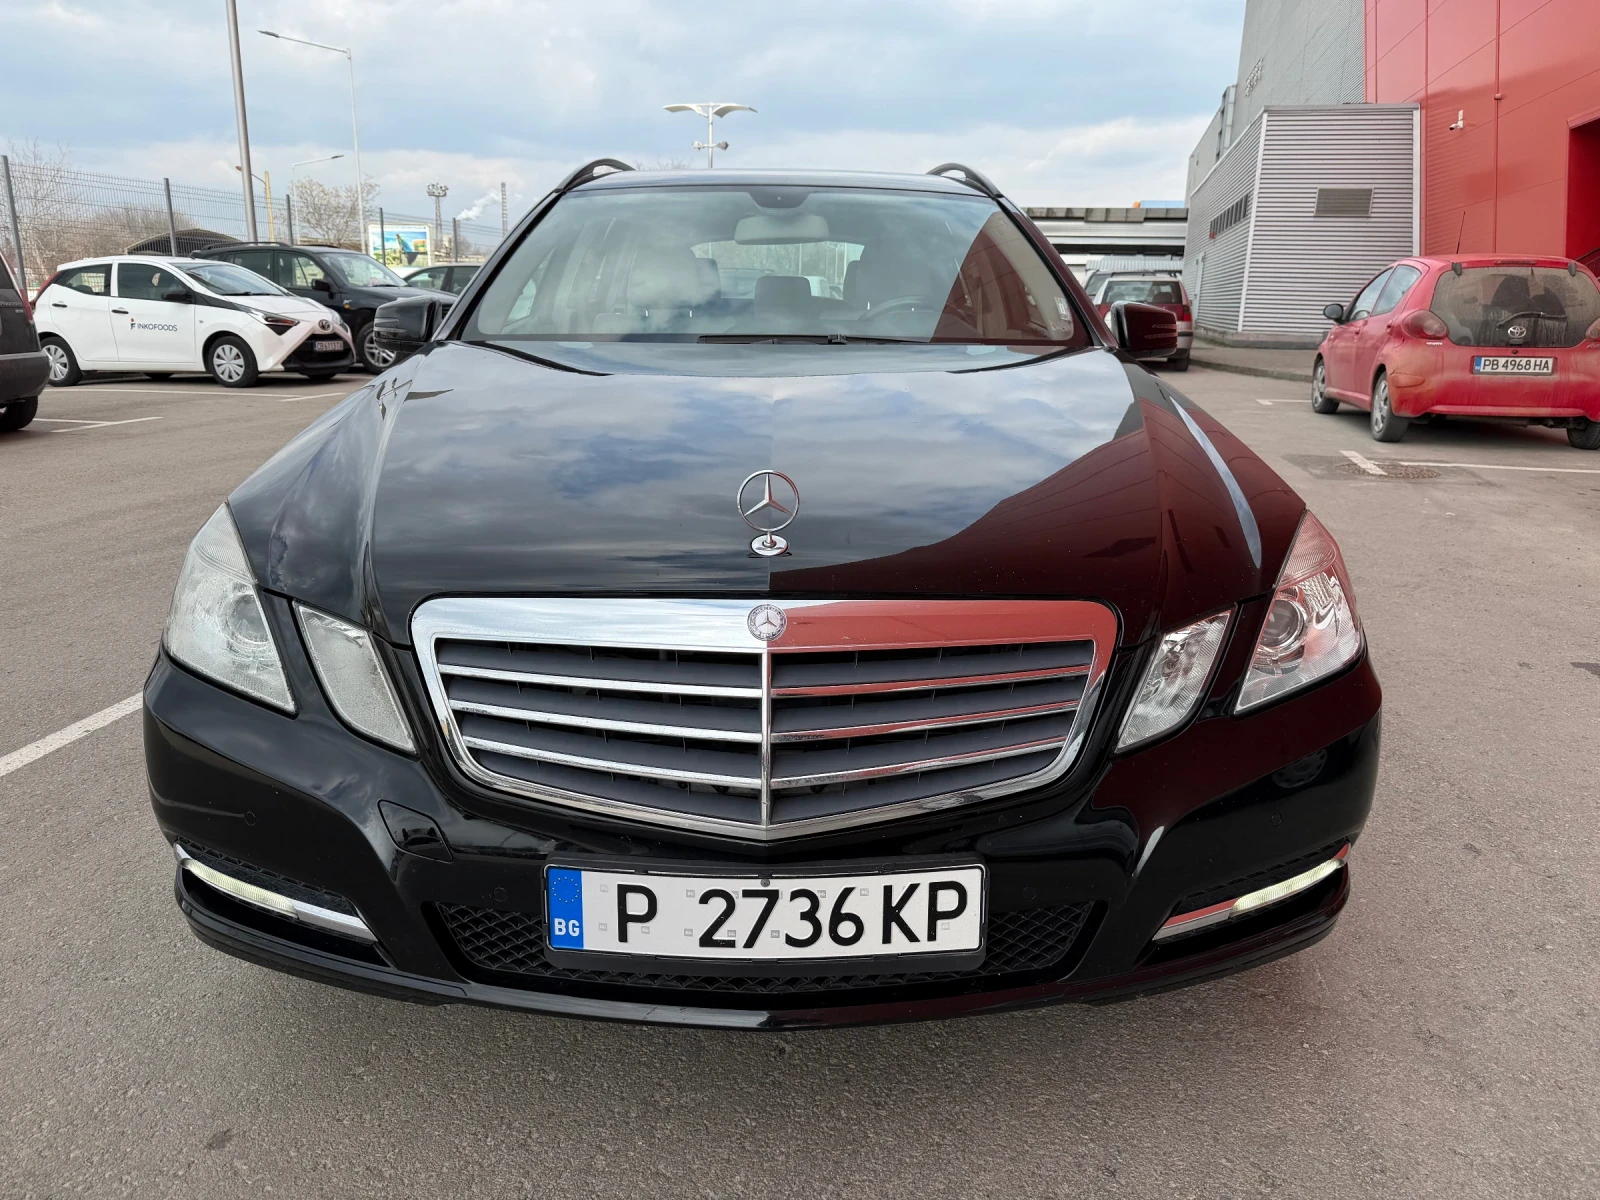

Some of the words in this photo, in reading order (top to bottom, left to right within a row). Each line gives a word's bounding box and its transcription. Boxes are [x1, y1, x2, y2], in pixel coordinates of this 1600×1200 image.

[137, 323, 178, 331] INKOFOODS
[1482, 359, 1499, 370] PB
[1501, 359, 1532, 371] 4968
[1533, 359, 1550, 371] HA
[617, 883, 658, 943] P
[698, 886, 864, 949] 2736
[882, 881, 968, 945] KP
[554, 918, 580, 937] BG
